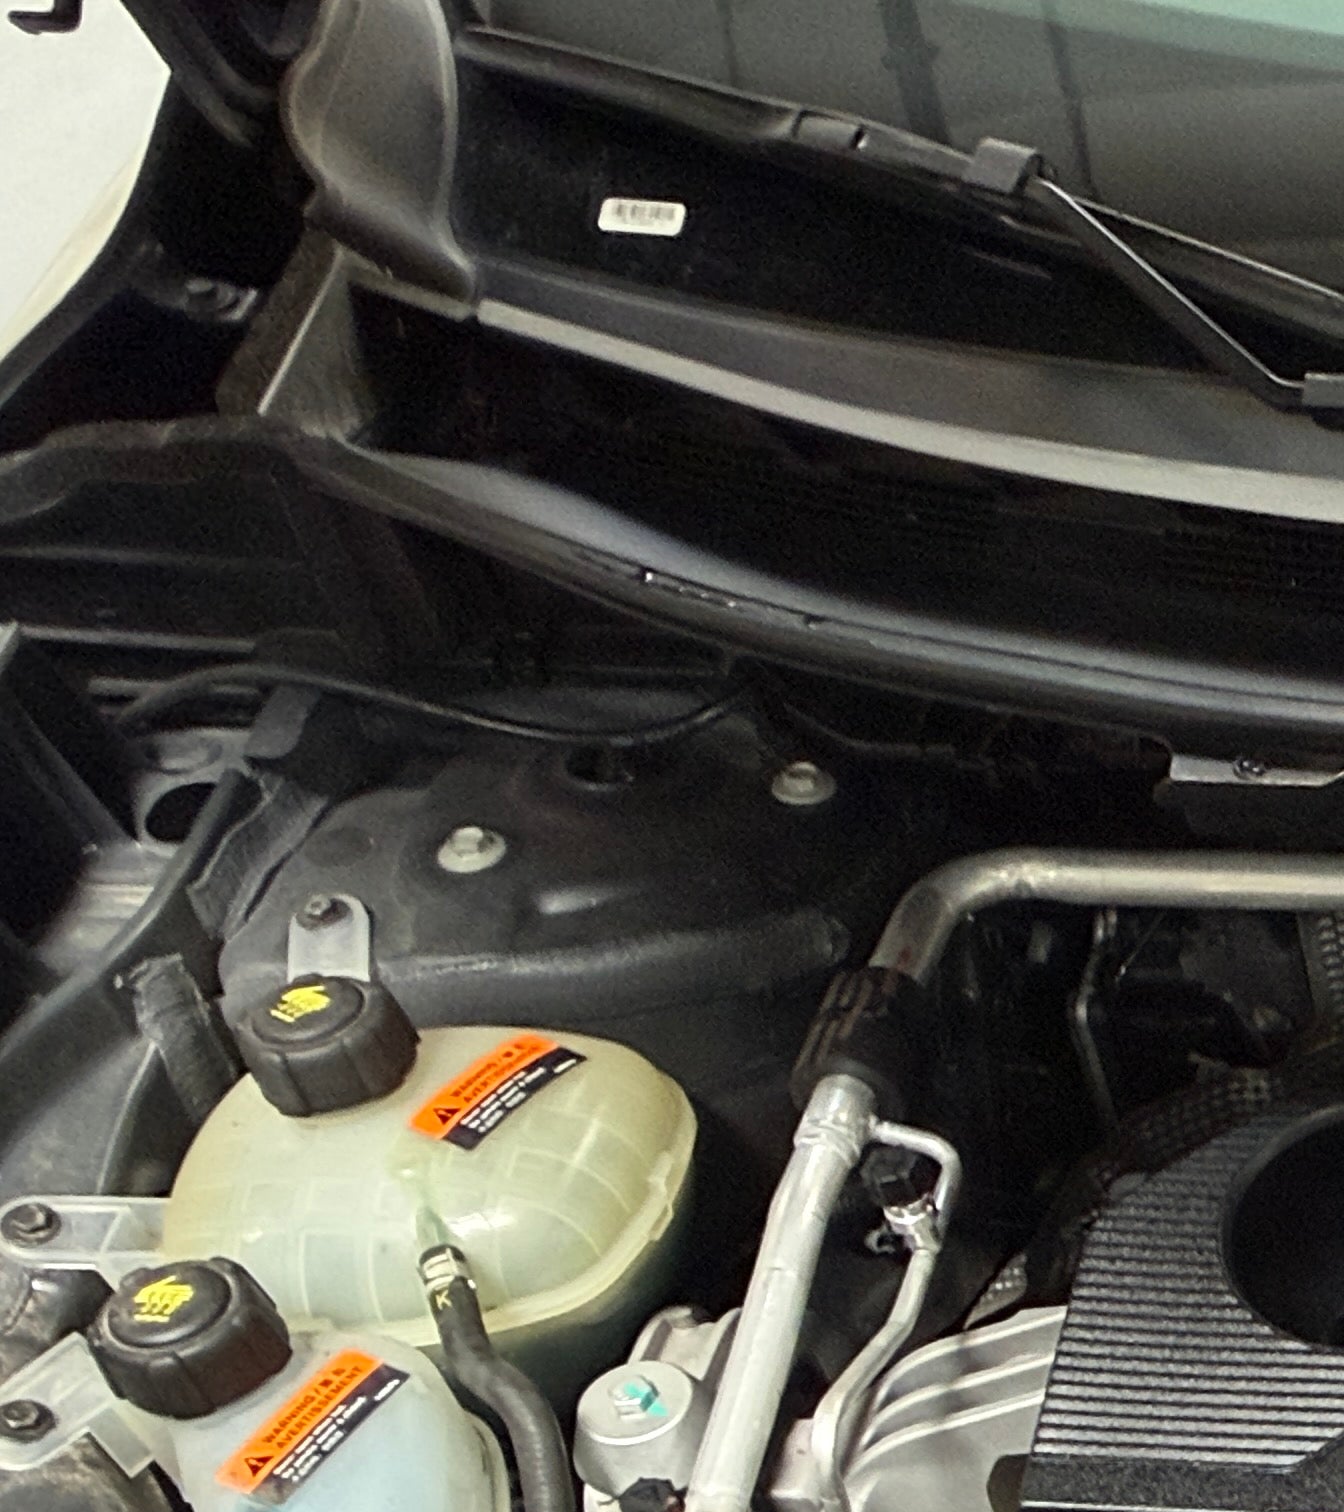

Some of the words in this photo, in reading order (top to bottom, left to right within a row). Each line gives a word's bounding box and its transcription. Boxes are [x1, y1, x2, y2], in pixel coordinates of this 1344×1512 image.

[435, 1289, 453, 1311] K
[261, 1394, 316, 1444] WARNING
[276, 1365, 363, 1449] AVERTISSEMENT
